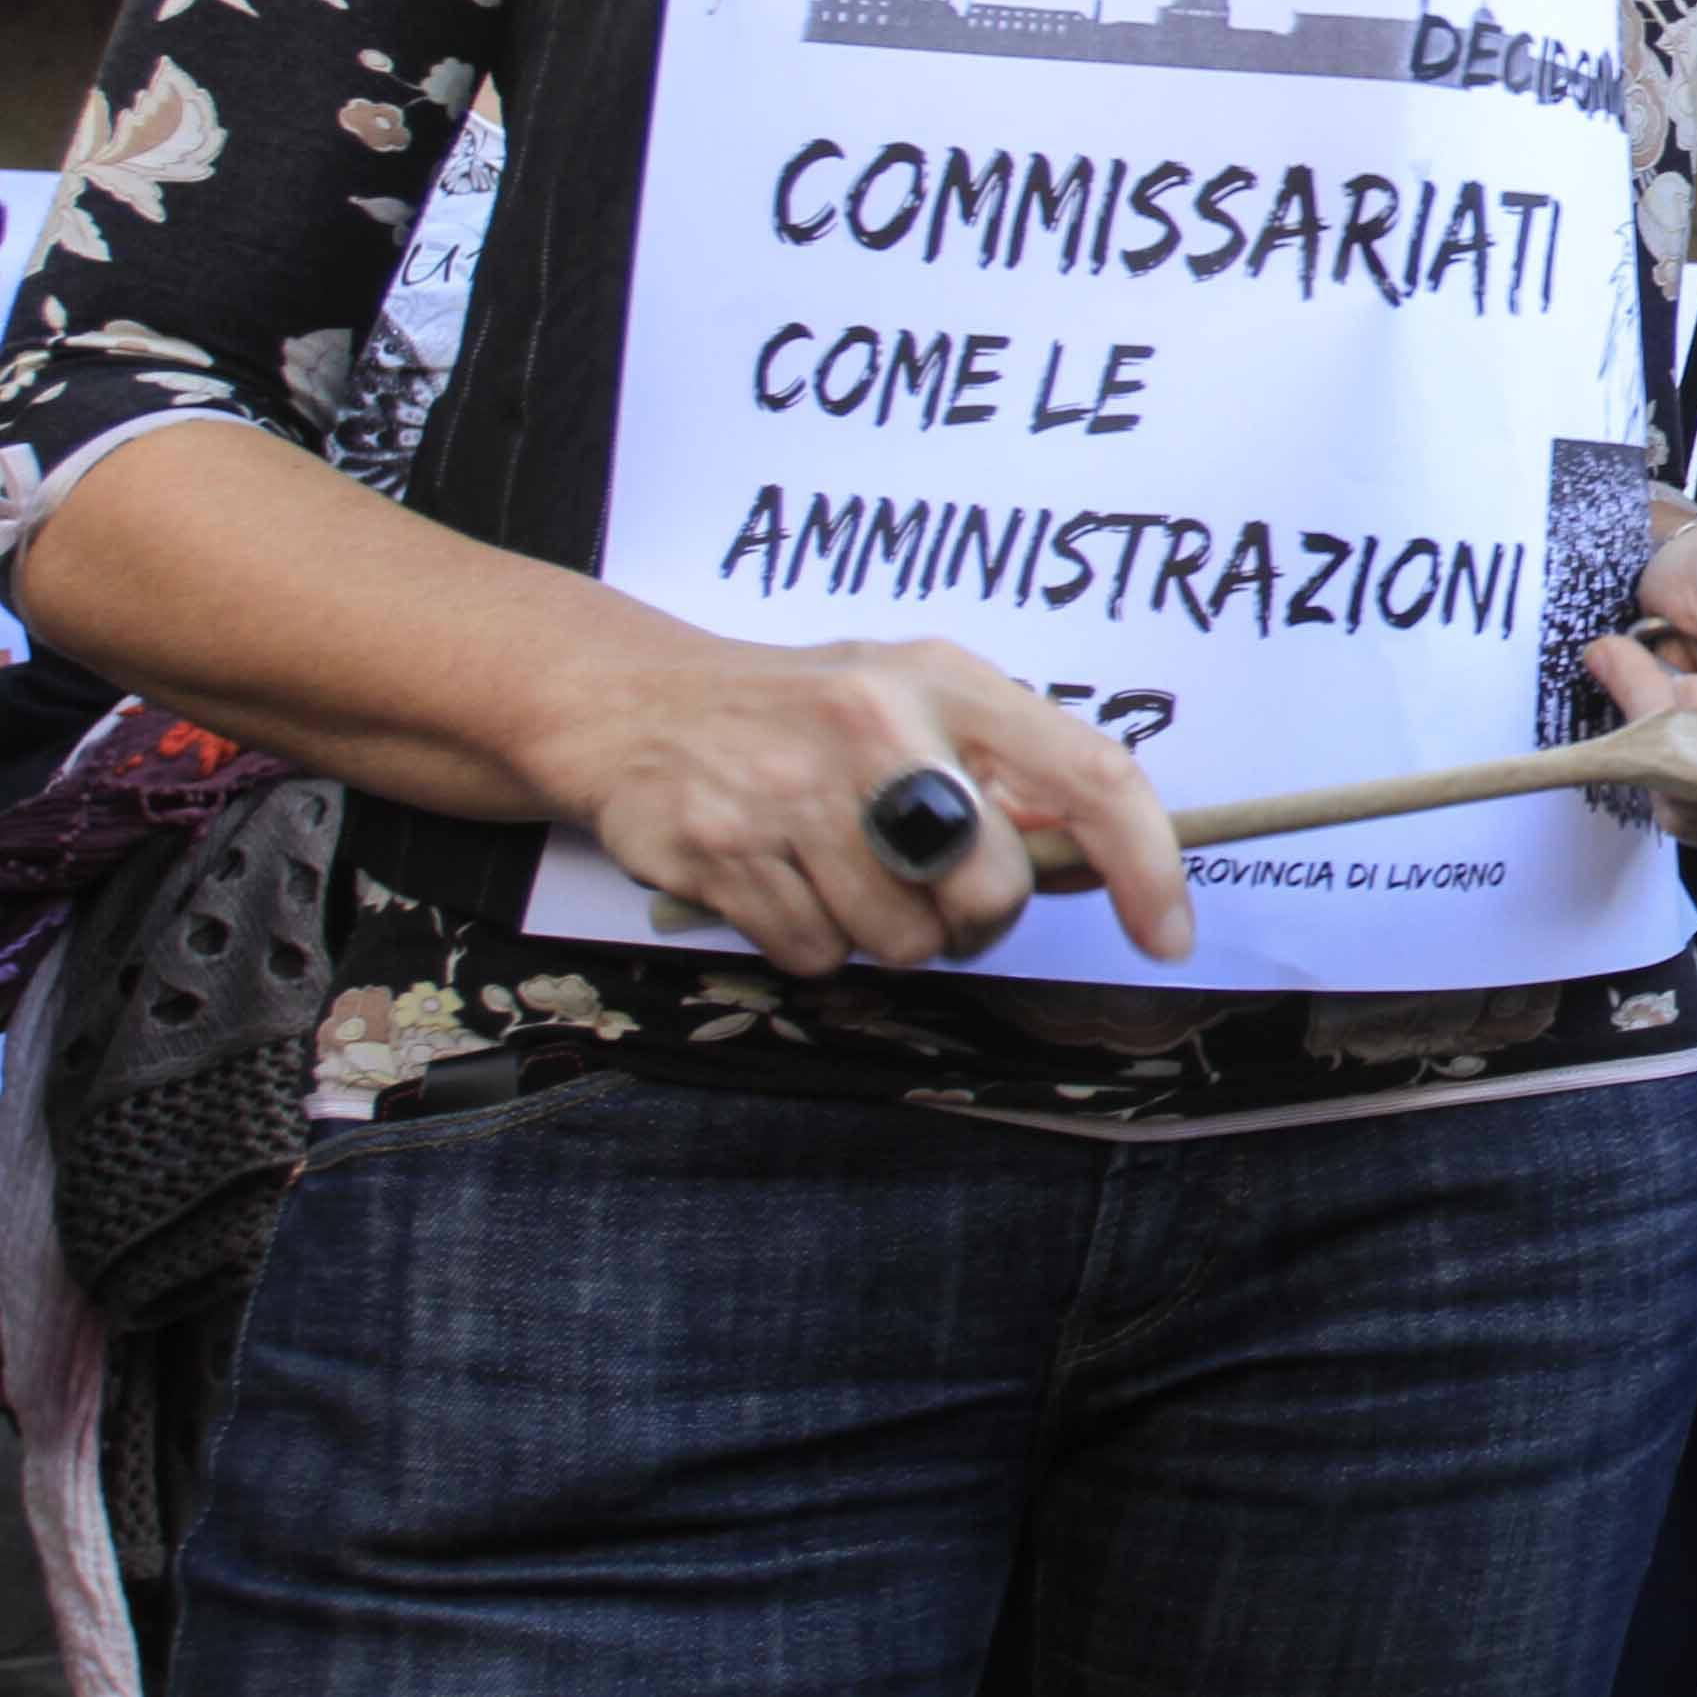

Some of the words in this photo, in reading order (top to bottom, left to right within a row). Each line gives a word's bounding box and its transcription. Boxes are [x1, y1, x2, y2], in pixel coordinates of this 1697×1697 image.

[772, 137, 1560, 315] COMMISSARIATI
[753, 321, 1011, 431] COME
[1028, 339, 1156, 435] LE
[719, 482, 1526, 640] AMMINISTRAZIONI
[1180, 855, 1334, 892] ROVINCIA
[1345, 861, 1376, 890] DI
[1385, 859, 1508, 892] LIVORNO
